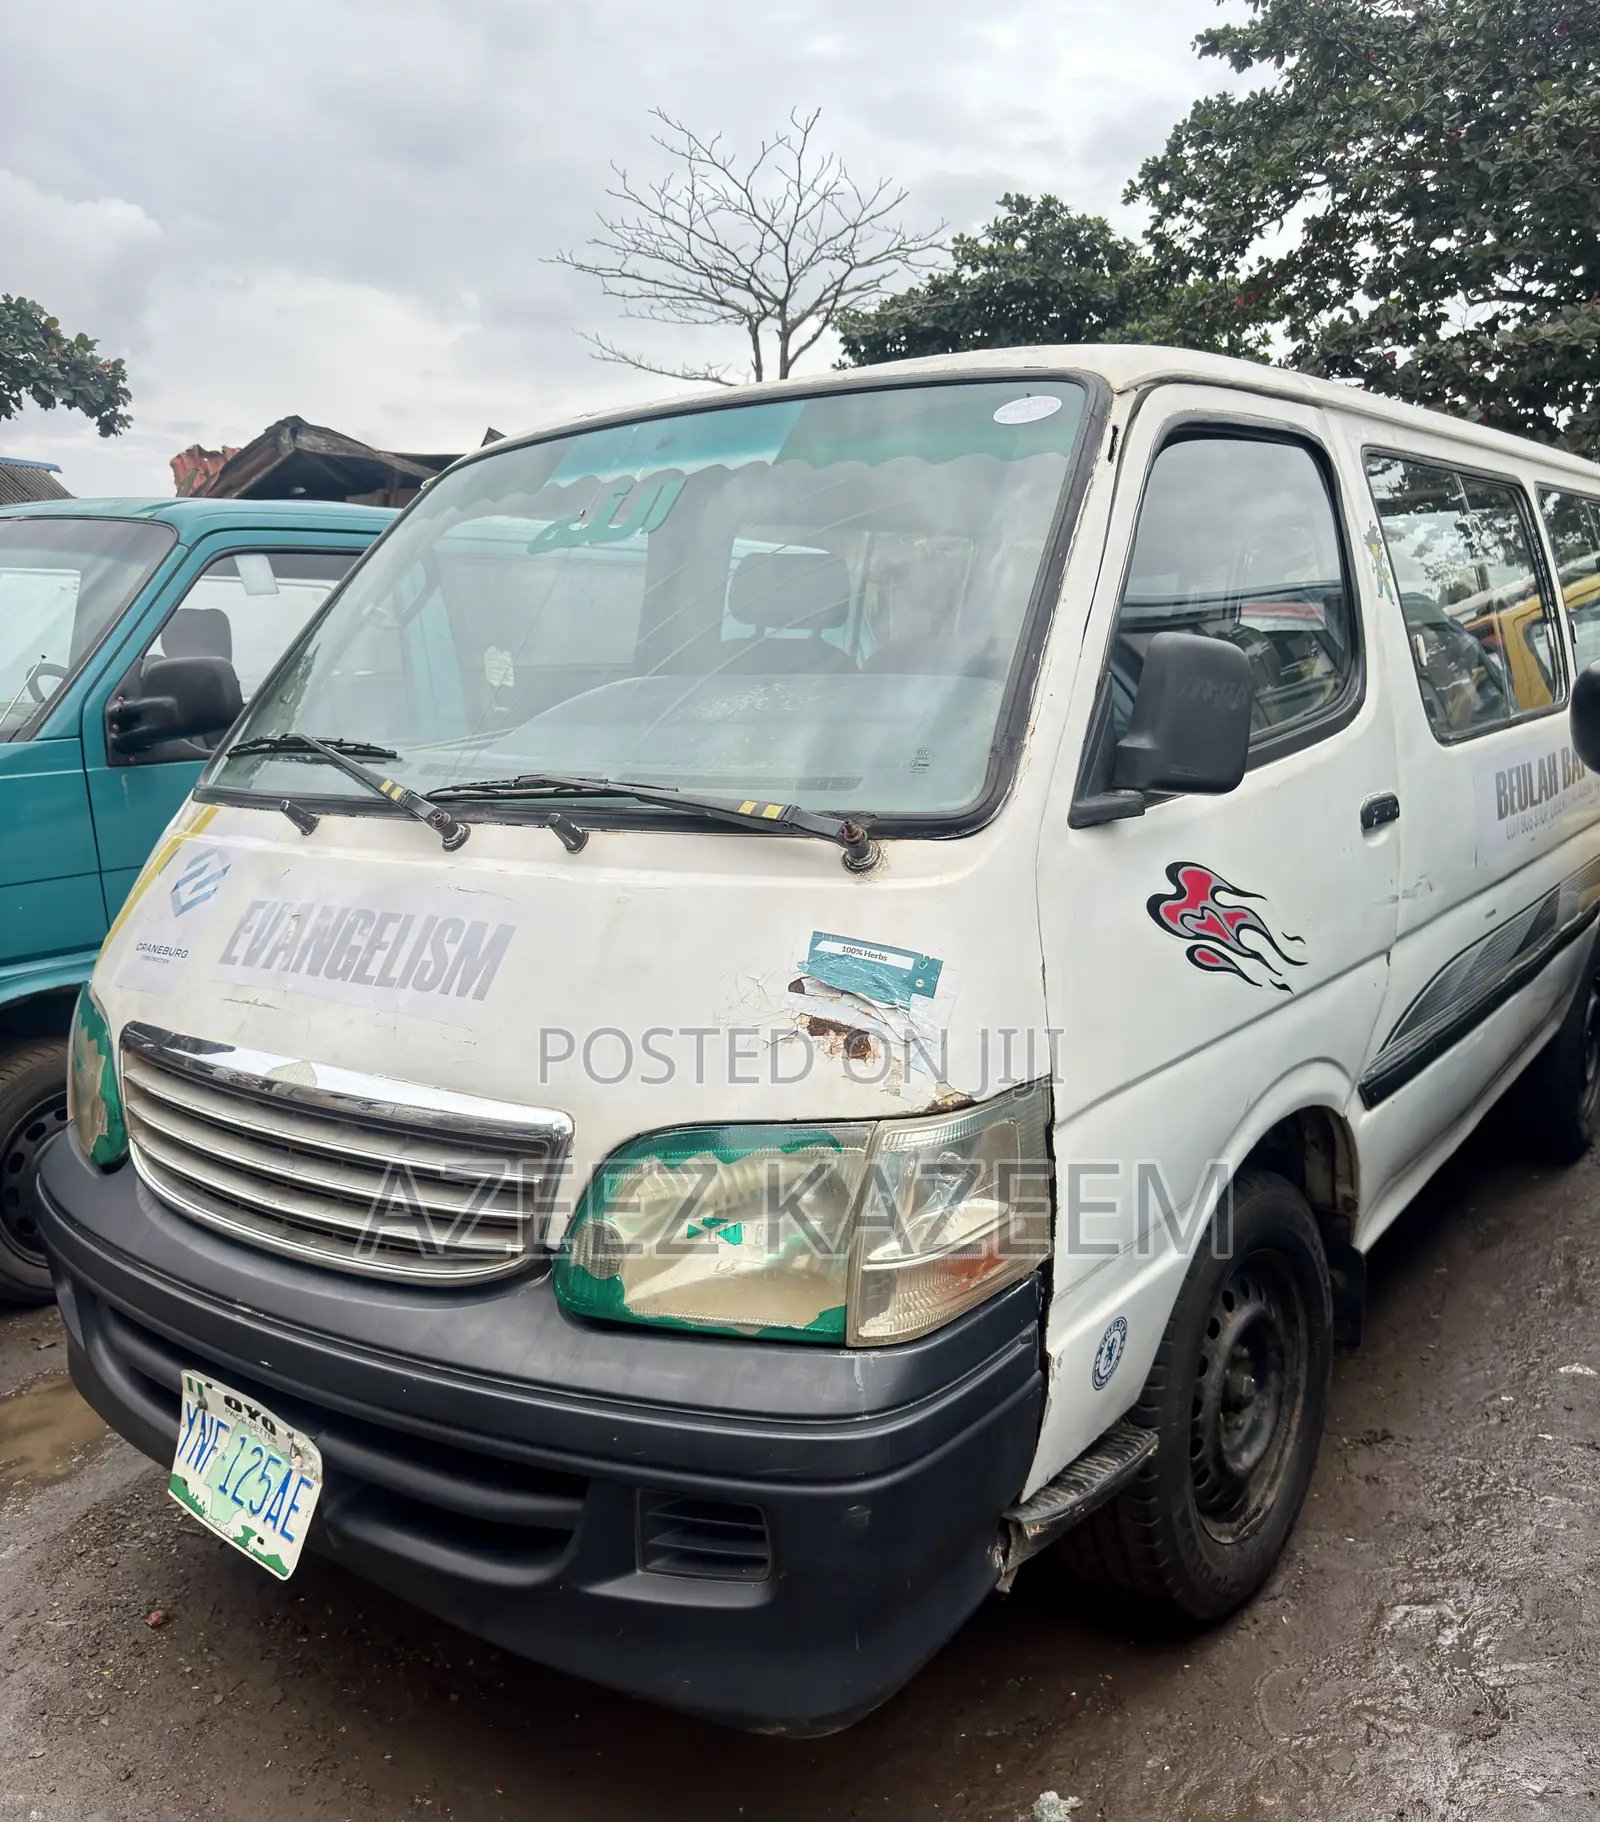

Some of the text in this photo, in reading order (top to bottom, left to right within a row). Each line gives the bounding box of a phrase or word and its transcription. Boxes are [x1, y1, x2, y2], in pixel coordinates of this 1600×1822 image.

[1495, 752, 1558, 821] BEULAH
[136, 942, 189, 959] CRANEBURG
[218, 900, 517, 1002] EVANGELISM
[841, 945, 888, 962] 100% Herbs
[224, 1395, 276, 1436] OYO
[225, 1407, 278, 1445] PACE SETTER
